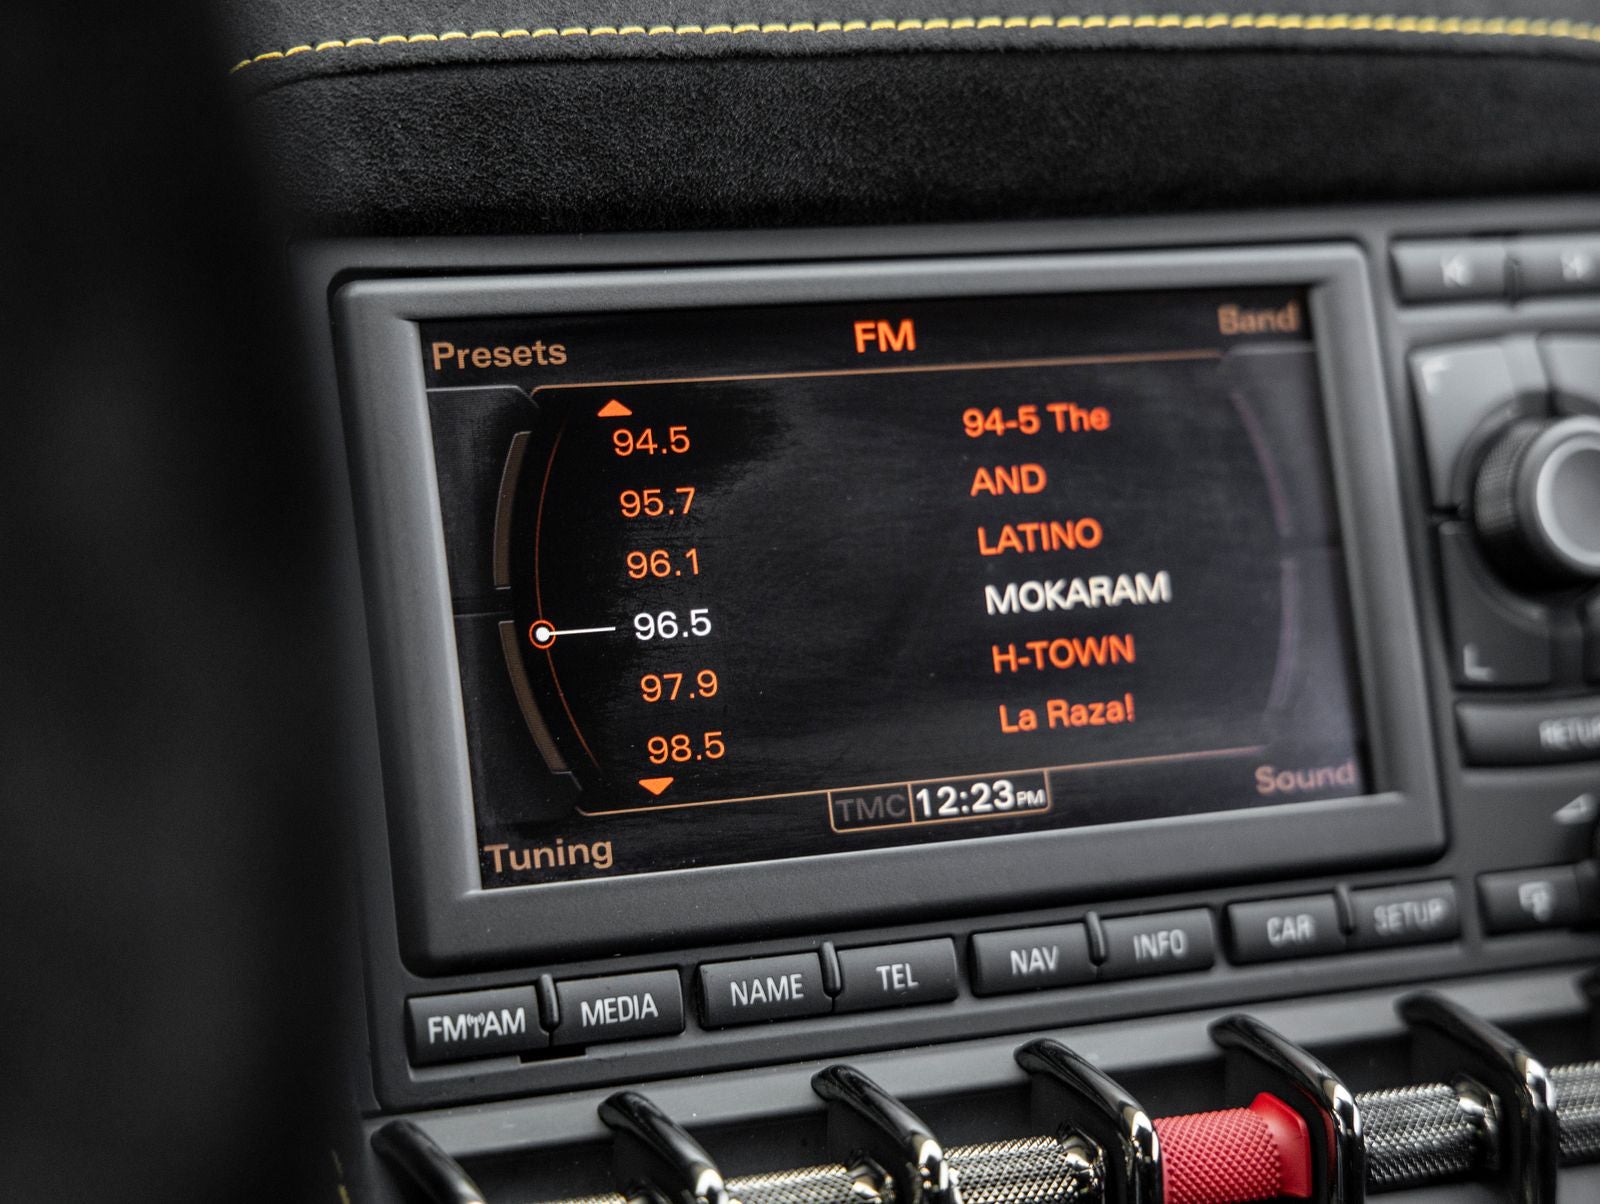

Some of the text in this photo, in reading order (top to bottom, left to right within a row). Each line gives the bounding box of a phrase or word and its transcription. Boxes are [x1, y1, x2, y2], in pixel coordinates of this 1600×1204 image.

[1218, 303, 1299, 335] Band
[853, 318, 916, 354] FM
[431, 340, 568, 370] Presets
[963, 403, 1111, 437] 94-5 The
[612, 426, 691, 457] 94.5
[970, 464, 1048, 496] AND
[620, 487, 696, 518] 95.7
[978, 518, 1104, 556] LATINO
[626, 548, 701, 580] 96.1
[985, 570, 1172, 615] MOKARAM
[633, 608, 713, 641] 96.5
[992, 633, 1136, 674] H-TOWN
[640, 669, 719, 702] 97.9
[999, 693, 1136, 734] La Raza!
[647, 731, 726, 765] 98.5
[1254, 762, 1357, 795] Sound
[835, 793, 908, 823] TMC
[916, 780, 1047, 818] 12:23 PM
[484, 838, 614, 874] Tuning
[1266, 914, 1316, 946] CAR
[1373, 898, 1445, 936] SETUP
[1133, 928, 1186, 961] INFO
[875, 963, 919, 992] TEL
[1009, 946, 1060, 977] NAV
[729, 973, 804, 1007] NAME
[580, 992, 660, 1028] MEDIA
